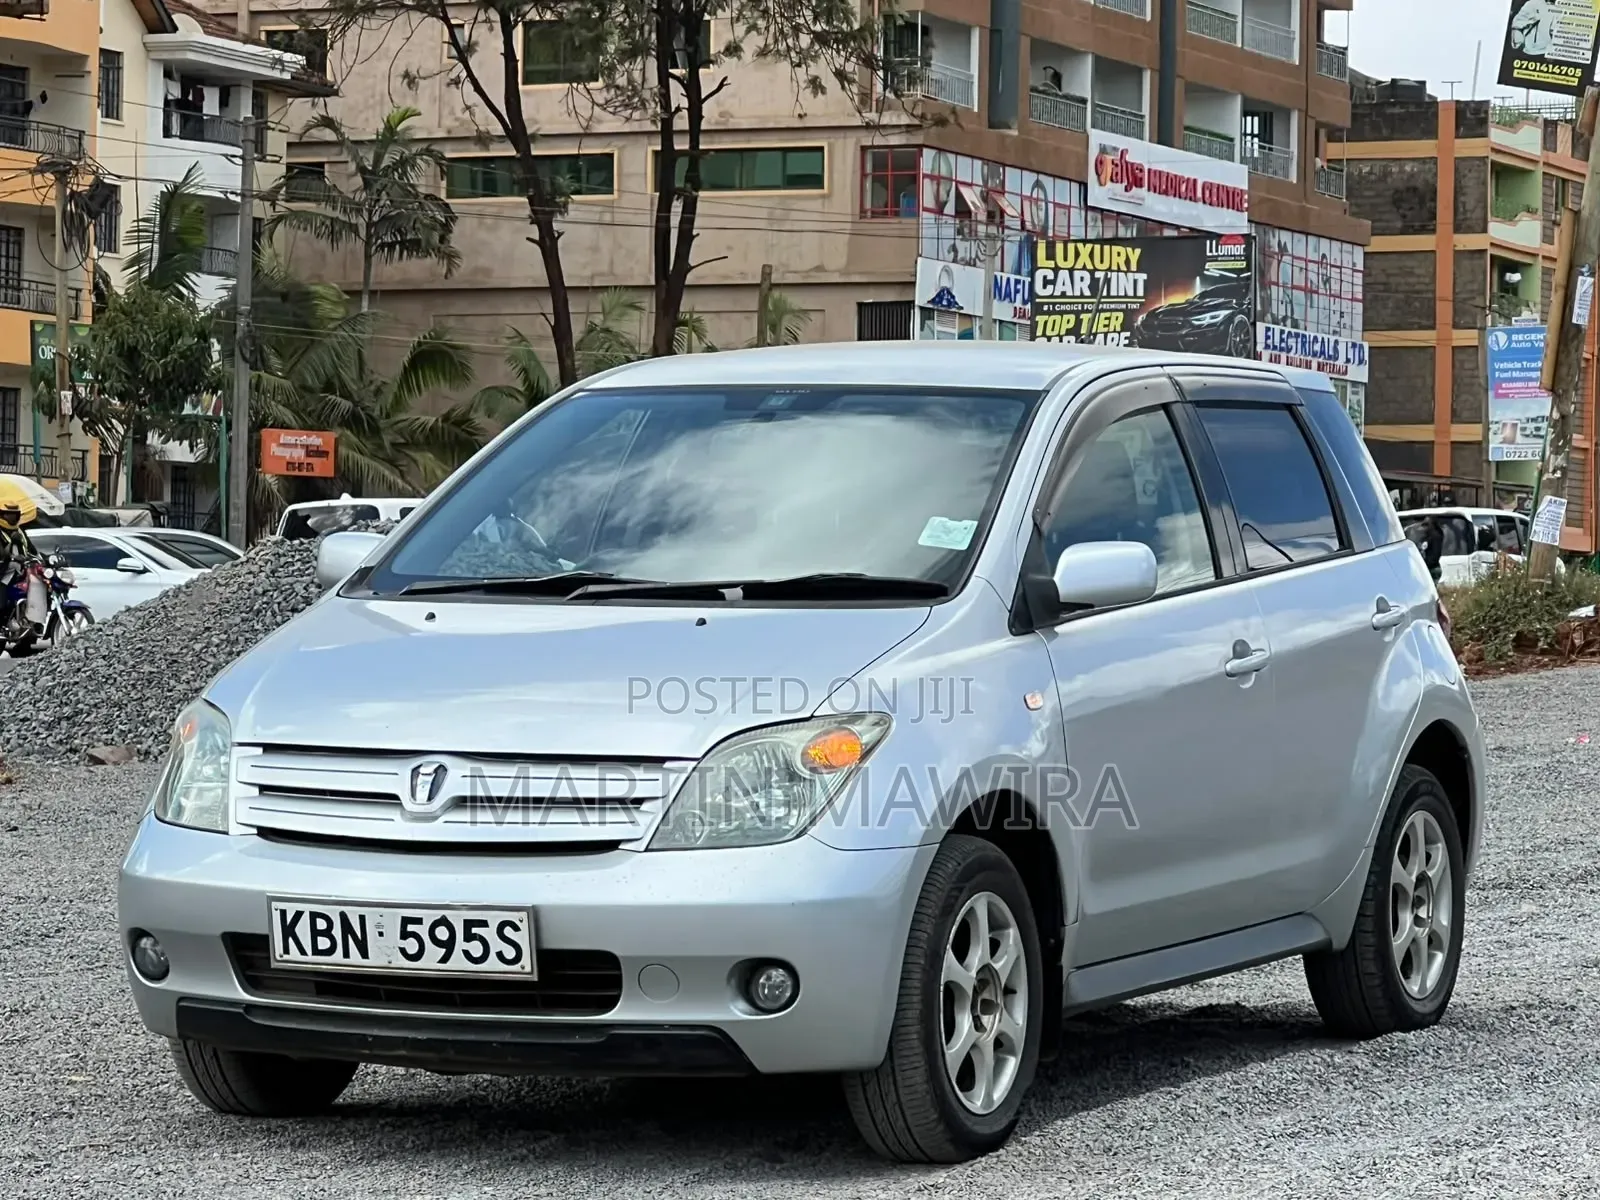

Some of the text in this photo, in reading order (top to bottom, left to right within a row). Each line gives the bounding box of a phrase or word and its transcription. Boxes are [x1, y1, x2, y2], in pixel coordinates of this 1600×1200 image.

[1513, 59, 1582, 77] 0701414705
[1147, 167, 1199, 203] MEDICAL
[1202, 180, 1248, 212] CENTRE
[1037, 239, 1142, 272] LUXURY
[1034, 268, 1148, 297] CAR TINT
[1043, 303, 1053, 311] #1
[1055, 303, 1082, 311] CHOICE
[1035, 311, 1124, 336] TOP TIER
[1263, 326, 1340, 362] ELECTRICALS
[1511, 333, 1545, 341] REGEN
[1317, 361, 1348, 376] MATERIALS
[1494, 361, 1521, 369] Vehicle
[1505, 451, 1528, 459] 0722
[278, 908, 524, 966] KBN 595S
